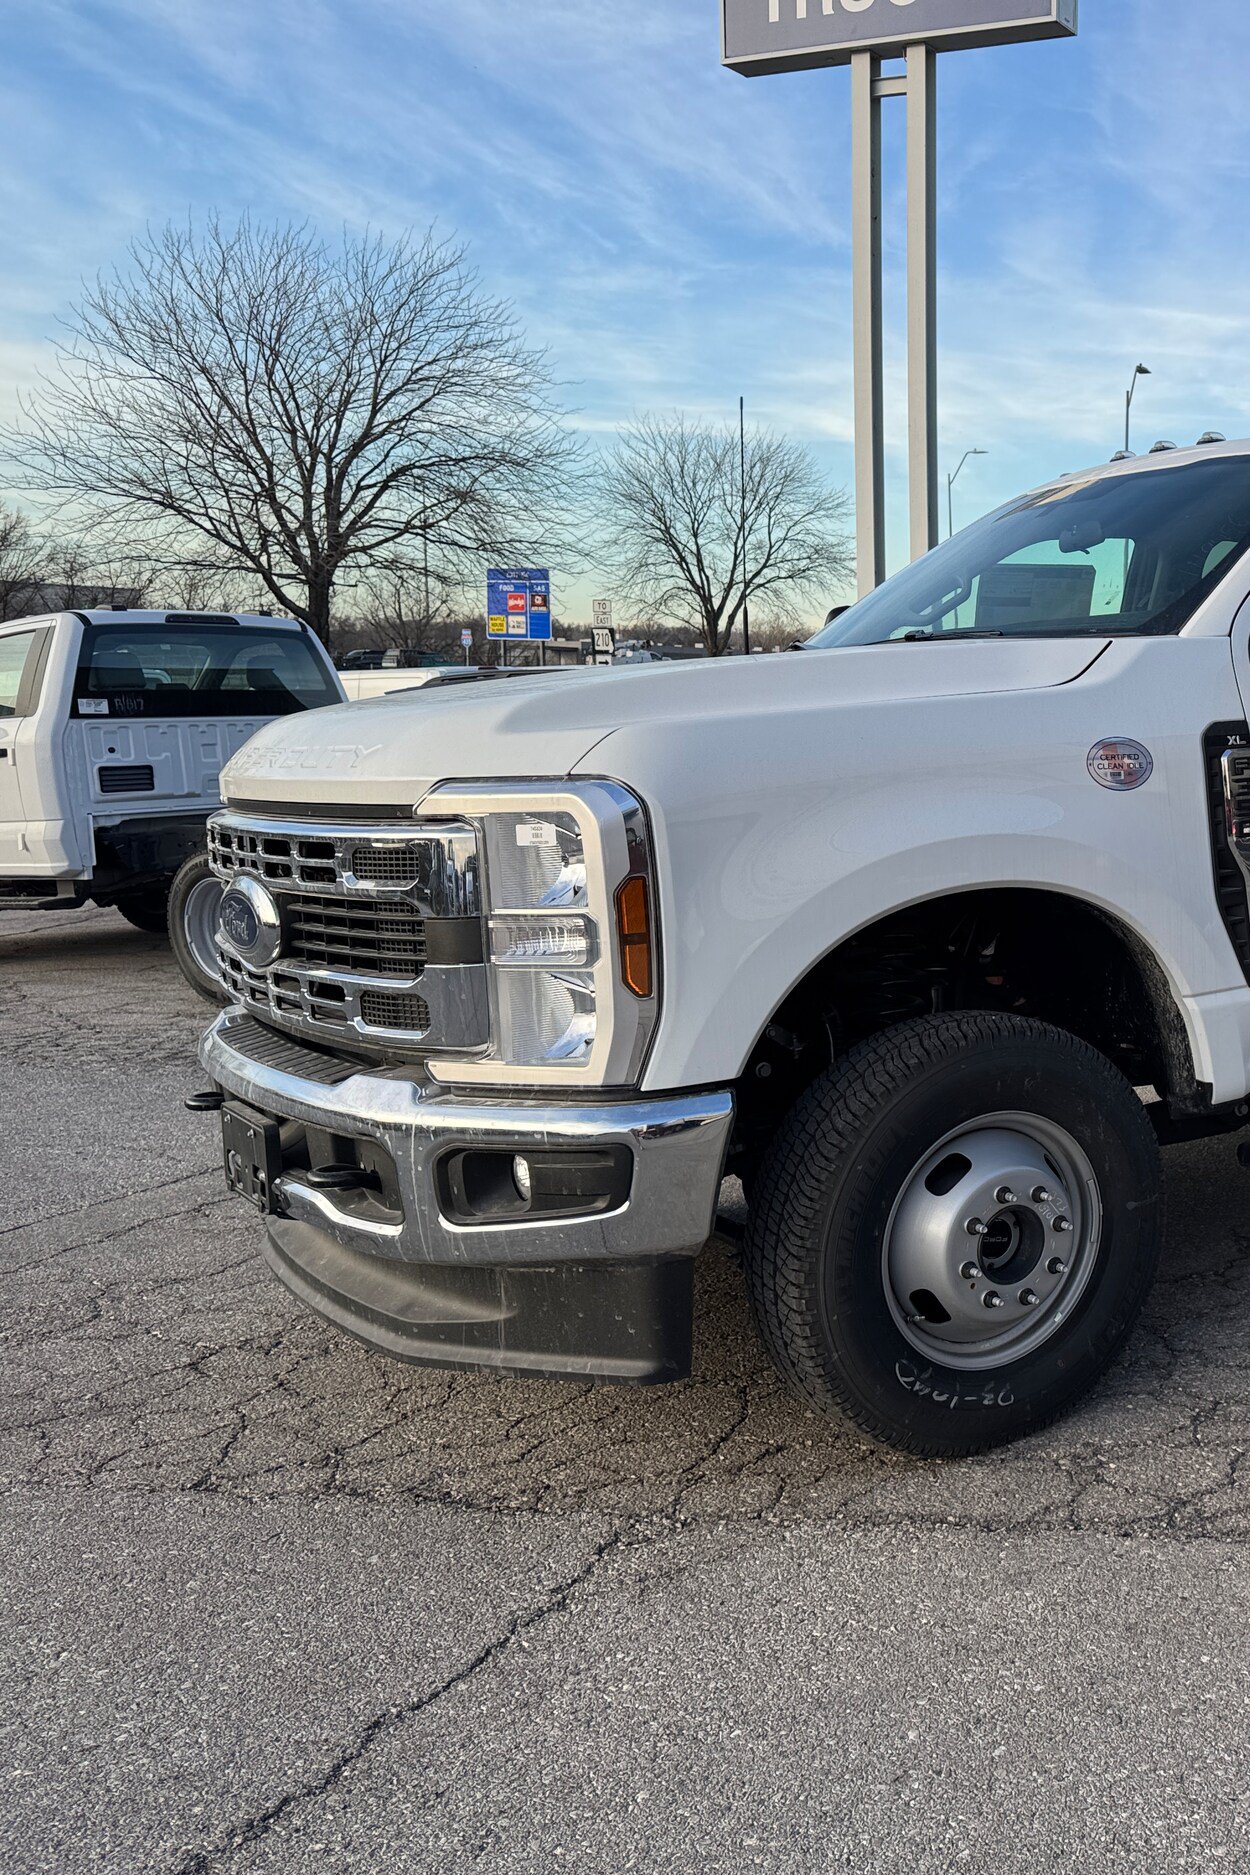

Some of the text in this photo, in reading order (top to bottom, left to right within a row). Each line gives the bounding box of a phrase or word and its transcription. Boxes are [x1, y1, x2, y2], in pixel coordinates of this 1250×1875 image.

[499, 584, 514, 592] FOOD
[597, 602, 607, 610] TO
[596, 615, 609, 625] EAST
[595, 632, 610, 647] 210
[1226, 735, 1247, 746] XL
[1099, 753, 1140, 761] CERTIFIED
[1097, 762, 1124, 770] CLEAN
